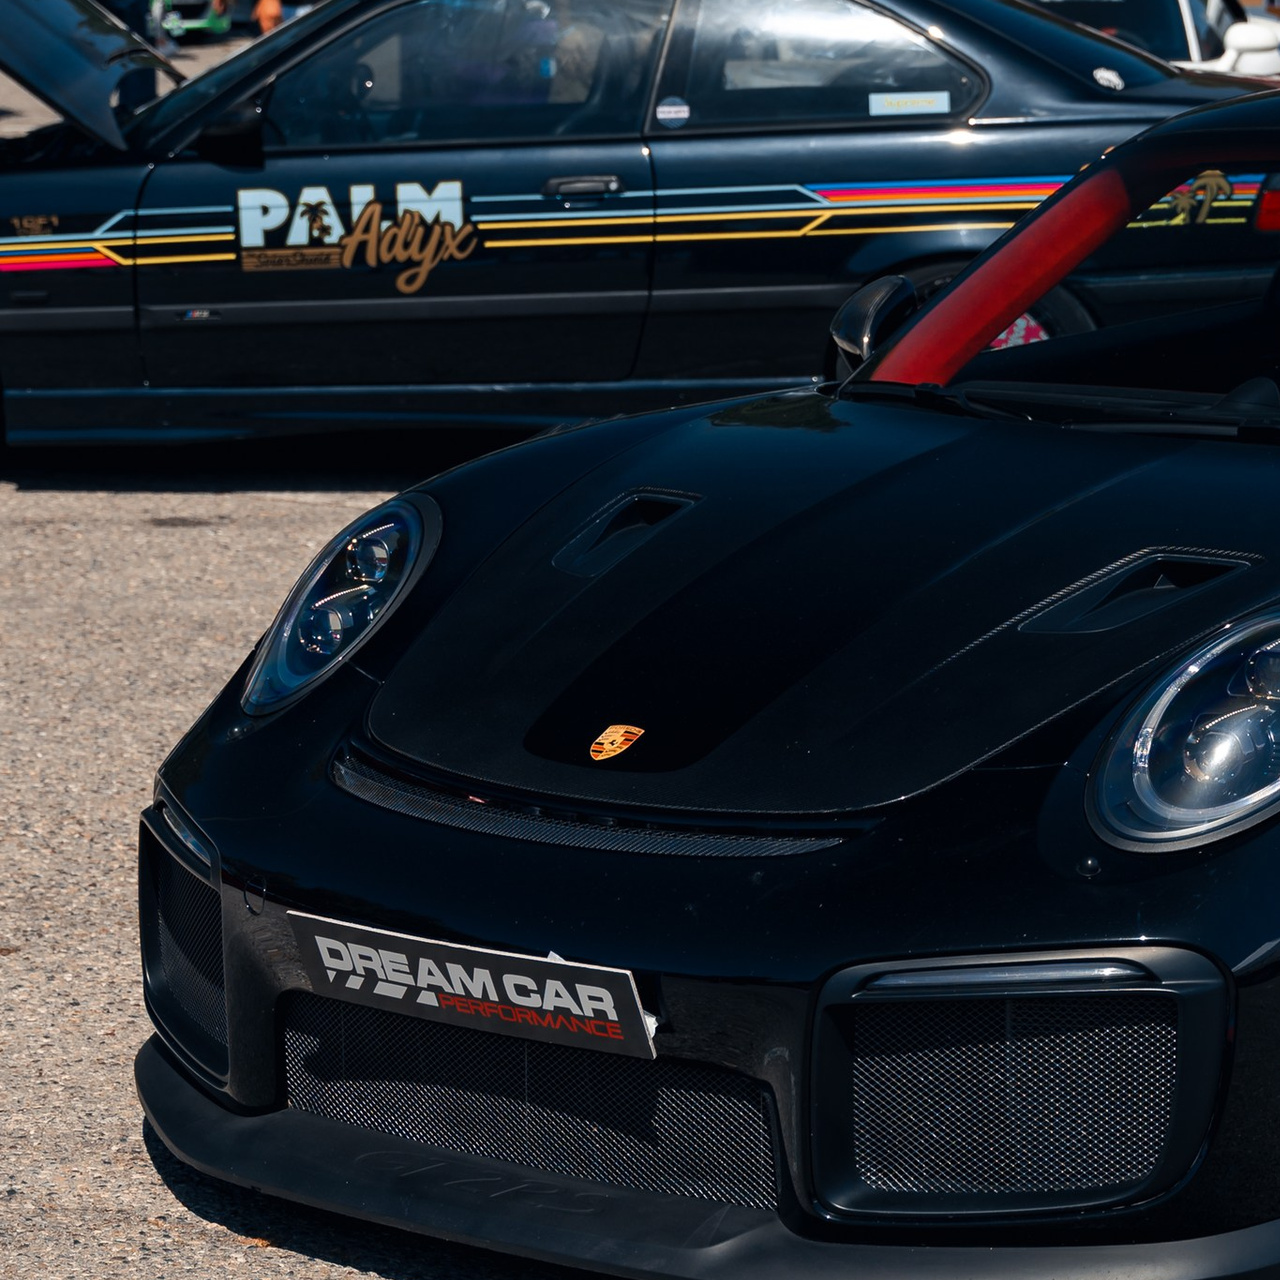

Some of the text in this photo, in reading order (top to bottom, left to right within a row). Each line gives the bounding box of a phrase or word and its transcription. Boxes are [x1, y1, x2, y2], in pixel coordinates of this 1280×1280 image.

[339, 200, 478, 293] Adyx
[314, 935, 618, 1021] DREAM CAR
[439, 993, 624, 1040] PERFORMANCE
